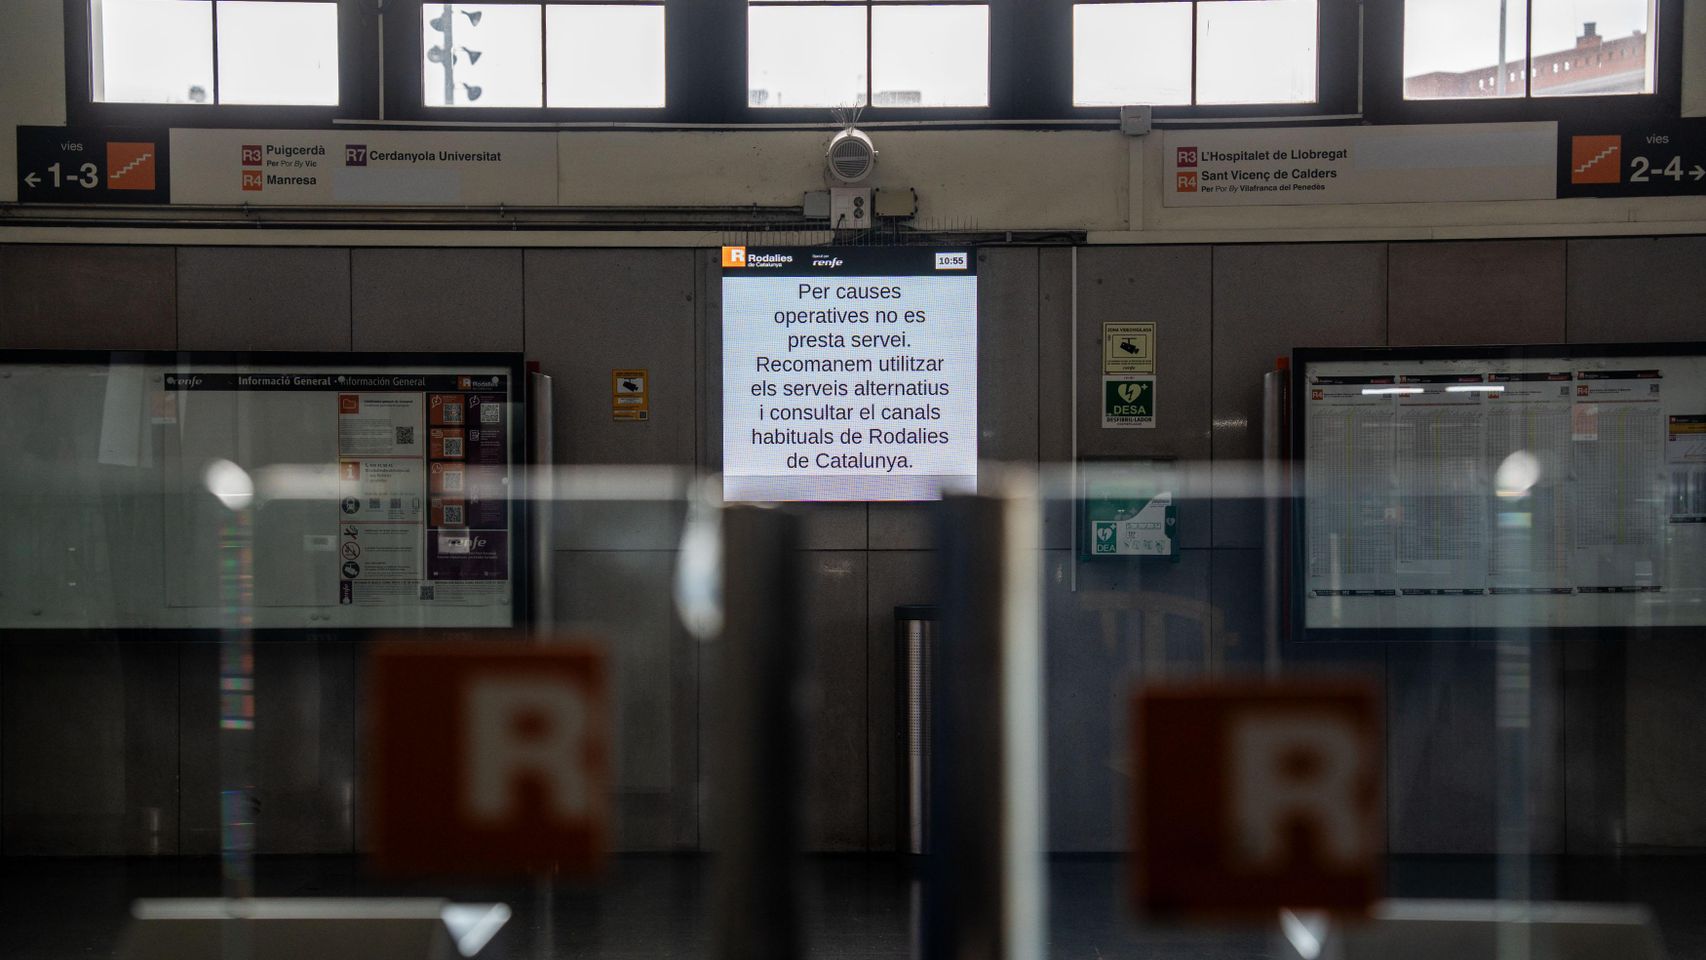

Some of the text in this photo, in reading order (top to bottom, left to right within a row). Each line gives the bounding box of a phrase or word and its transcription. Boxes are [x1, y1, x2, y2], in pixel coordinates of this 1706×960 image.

[60, 140, 83, 151] vies
[1646, 133, 1670, 144] vies
[243, 144, 325, 162] R3 Puigcerdà
[346, 148, 502, 163] R7 Cerdanyola Universitat
[1178, 148, 1347, 163] R3 L'Hospitalet de Llobregat
[294, 160, 303, 168] By
[1630, 155, 1684, 182] 2-4
[47, 162, 98, 188] 1-3
[243, 174, 317, 187] R4 Manresa
[1178, 168, 1337, 188] R4 Sant Vicenç de Calders
[1201, 185, 1214, 193] Per
[1229, 185, 1238, 193] By
[1240, 184, 1277, 192] Vilafranca
[1279, 183, 1291, 191] del
[731, 249, 793, 262] R Rodalies
[812, 257, 843, 269] renfe
[938, 256, 964, 265] 10:55
[799, 283, 901, 300] Per causes
[774, 307, 926, 328] operatives no es
[788, 331, 911, 352] presta servei.
[756, 355, 945, 372] Recomanem utilitzar
[239, 376, 290, 386] Informació
[294, 376, 332, 386] General
[341, 376, 391, 386] nformación
[393, 376, 425, 386] General
[751, 379, 950, 396] els serveis alternatius
[760, 403, 941, 420] i consultar el canals
[1113, 405, 1146, 415] DESA
[752, 427, 949, 444] habituals de Rodalies
[787, 452, 913, 472] de Catalunya.
[1097, 544, 1115, 552] DEA
[464, 674, 592, 822] R
[1230, 708, 1364, 866] R
